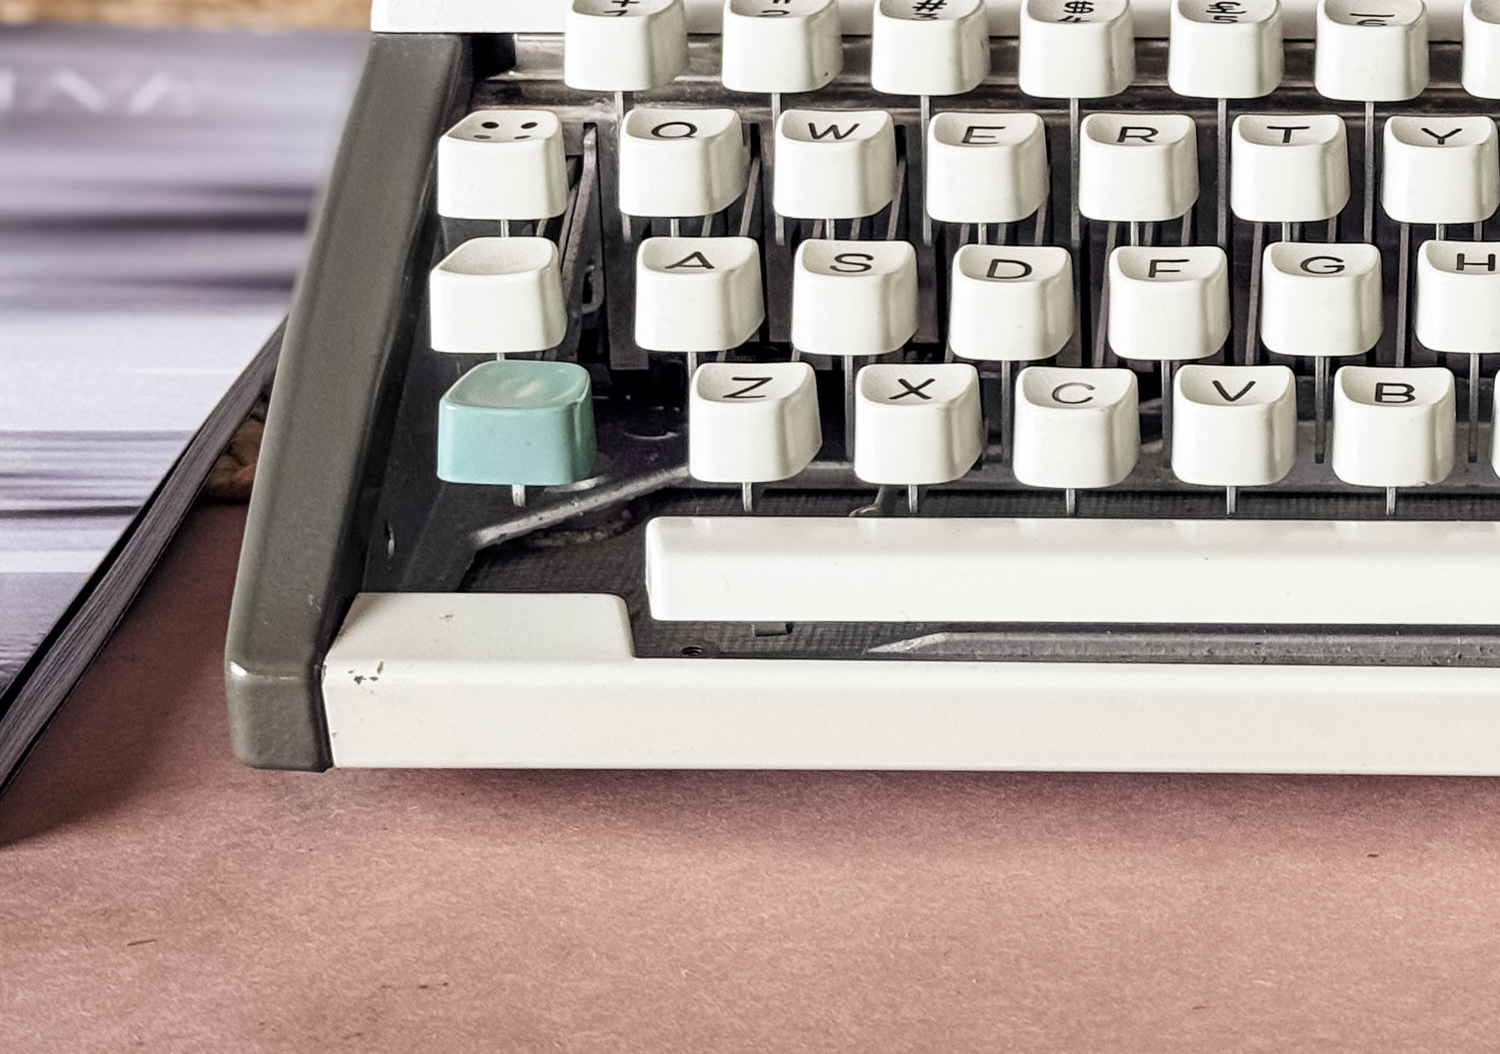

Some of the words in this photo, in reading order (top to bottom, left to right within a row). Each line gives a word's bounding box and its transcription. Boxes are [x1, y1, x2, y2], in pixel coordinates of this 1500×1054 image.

[1064, 1, 1094, 14] $
[1206, 2, 1246, 14] £
[651, 121, 699, 139] Q
[808, 123, 859, 140] W
[961, 126, 1005, 144] E
[1116, 127, 1158, 143] R
[1267, 126, 1310, 143] T
[1421, 128, 1462, 145] Y
[664, 252, 715, 269] A
[830, 253, 873, 272] S
[985, 258, 1033, 280] D
[1148, 259, 1189, 278] F
[1300, 256, 1345, 274] G
[1456, 253, 1495, 271] H
[723, 377, 772, 398] Z
[889, 379, 935, 400] X
[1052, 383, 1095, 404] C
[1212, 380, 1255, 402] V
[1375, 383, 1415, 403] B
